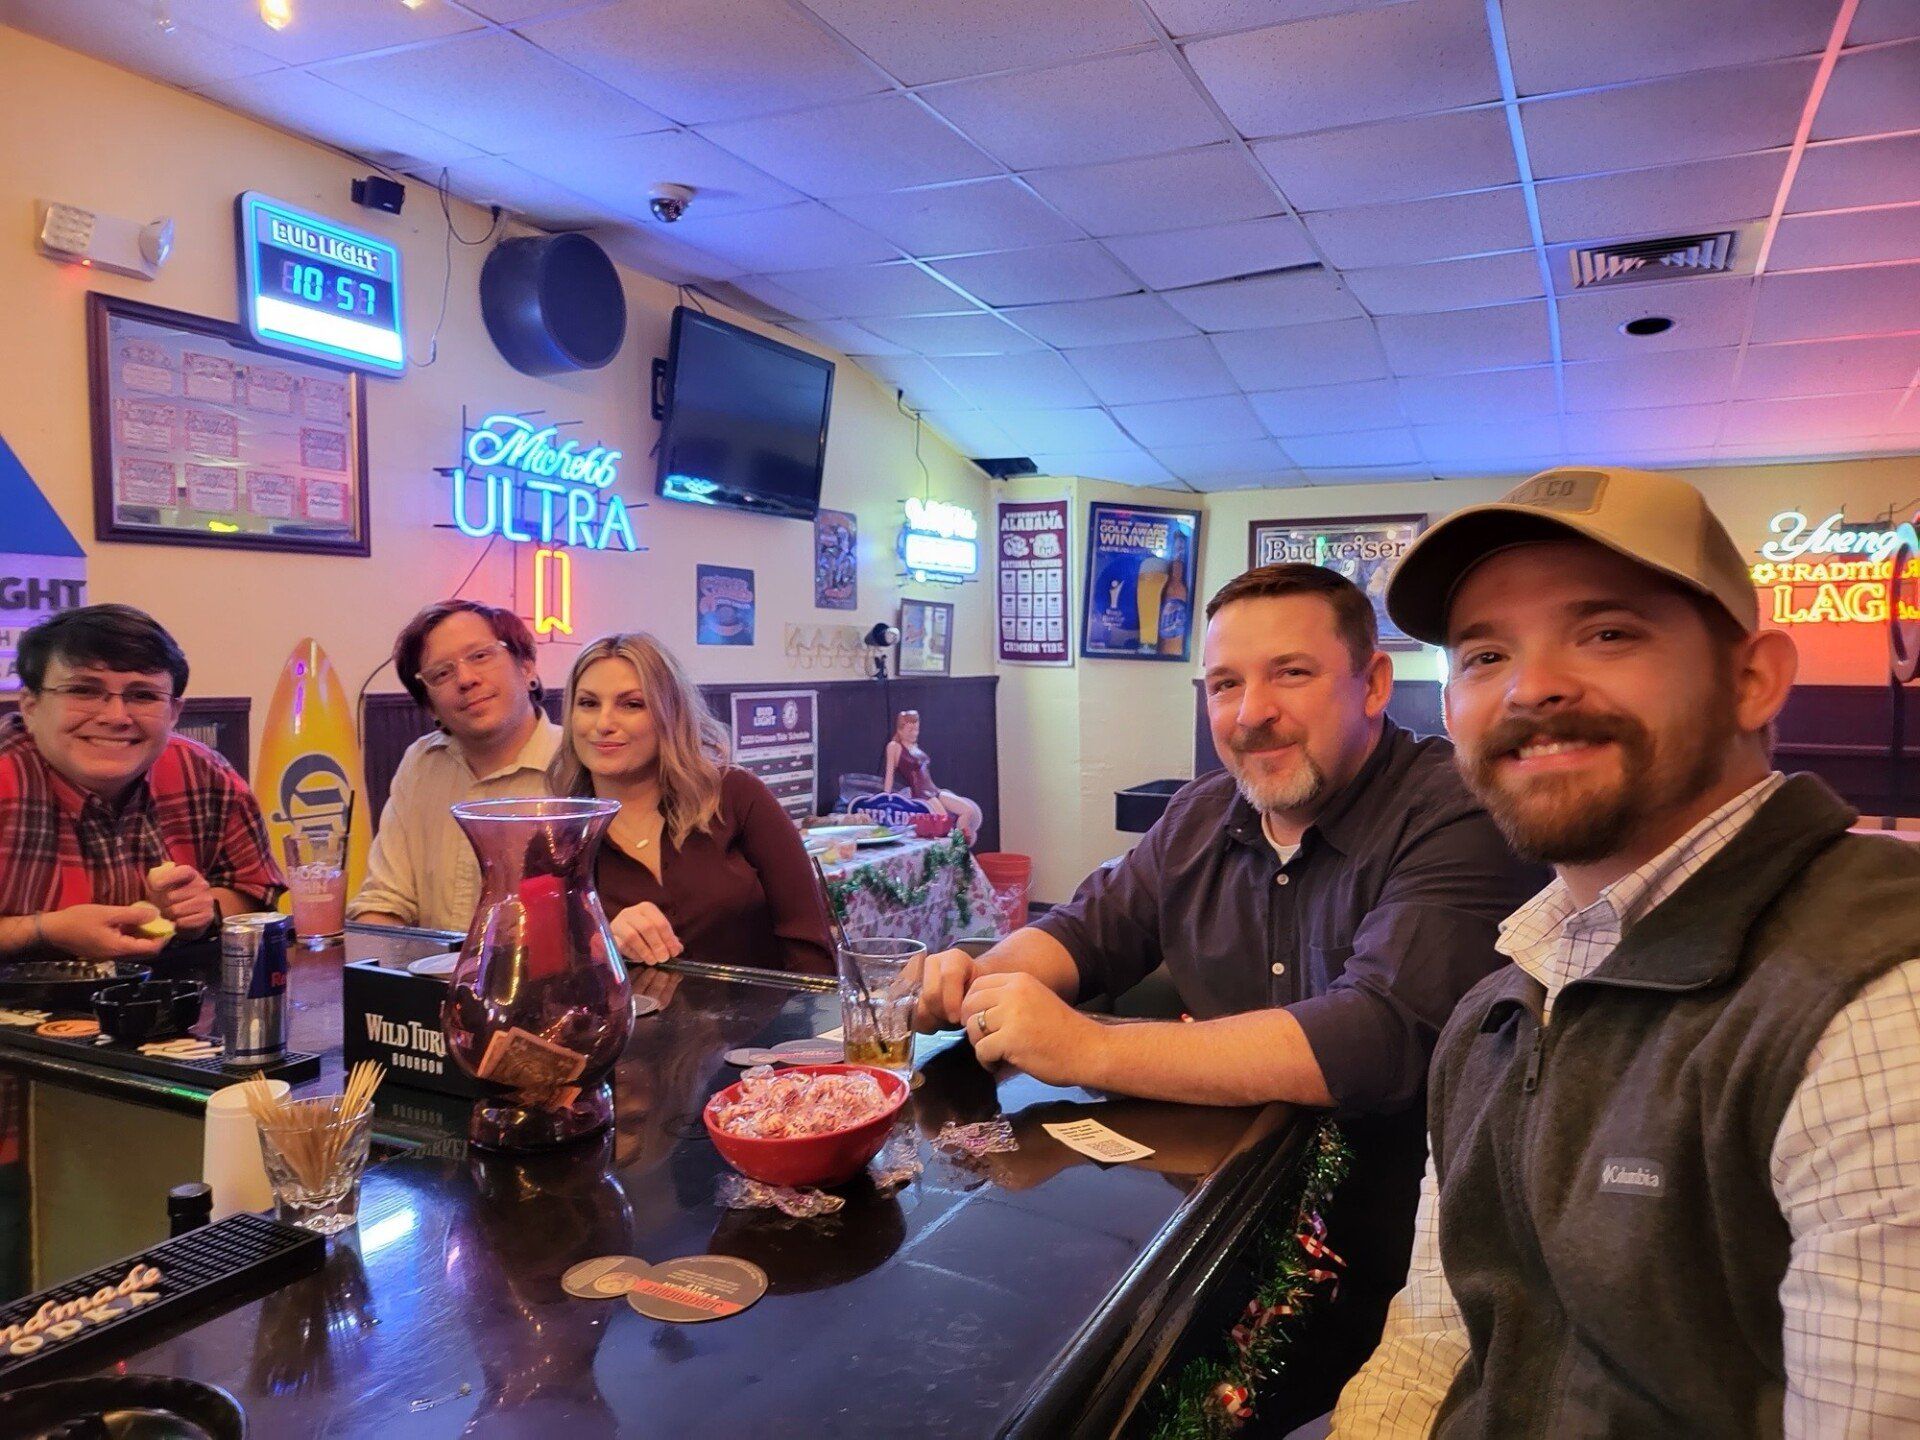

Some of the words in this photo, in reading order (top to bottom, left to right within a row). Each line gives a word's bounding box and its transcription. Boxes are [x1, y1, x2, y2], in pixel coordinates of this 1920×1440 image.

[271, 218, 319, 254] BUD
[319, 234, 379, 273] LIGHT
[453, 468, 638, 552] ULTRA
[1001, 514, 1065, 532] ALABAMA
[1100, 524, 1130, 536] GOLD
[1131, 526, 1168, 540] AWARD
[1100, 532, 1168, 550] WINNER
[365, 1012, 410, 1048] WILD
[391, 1052, 444, 1075] BOURBON
